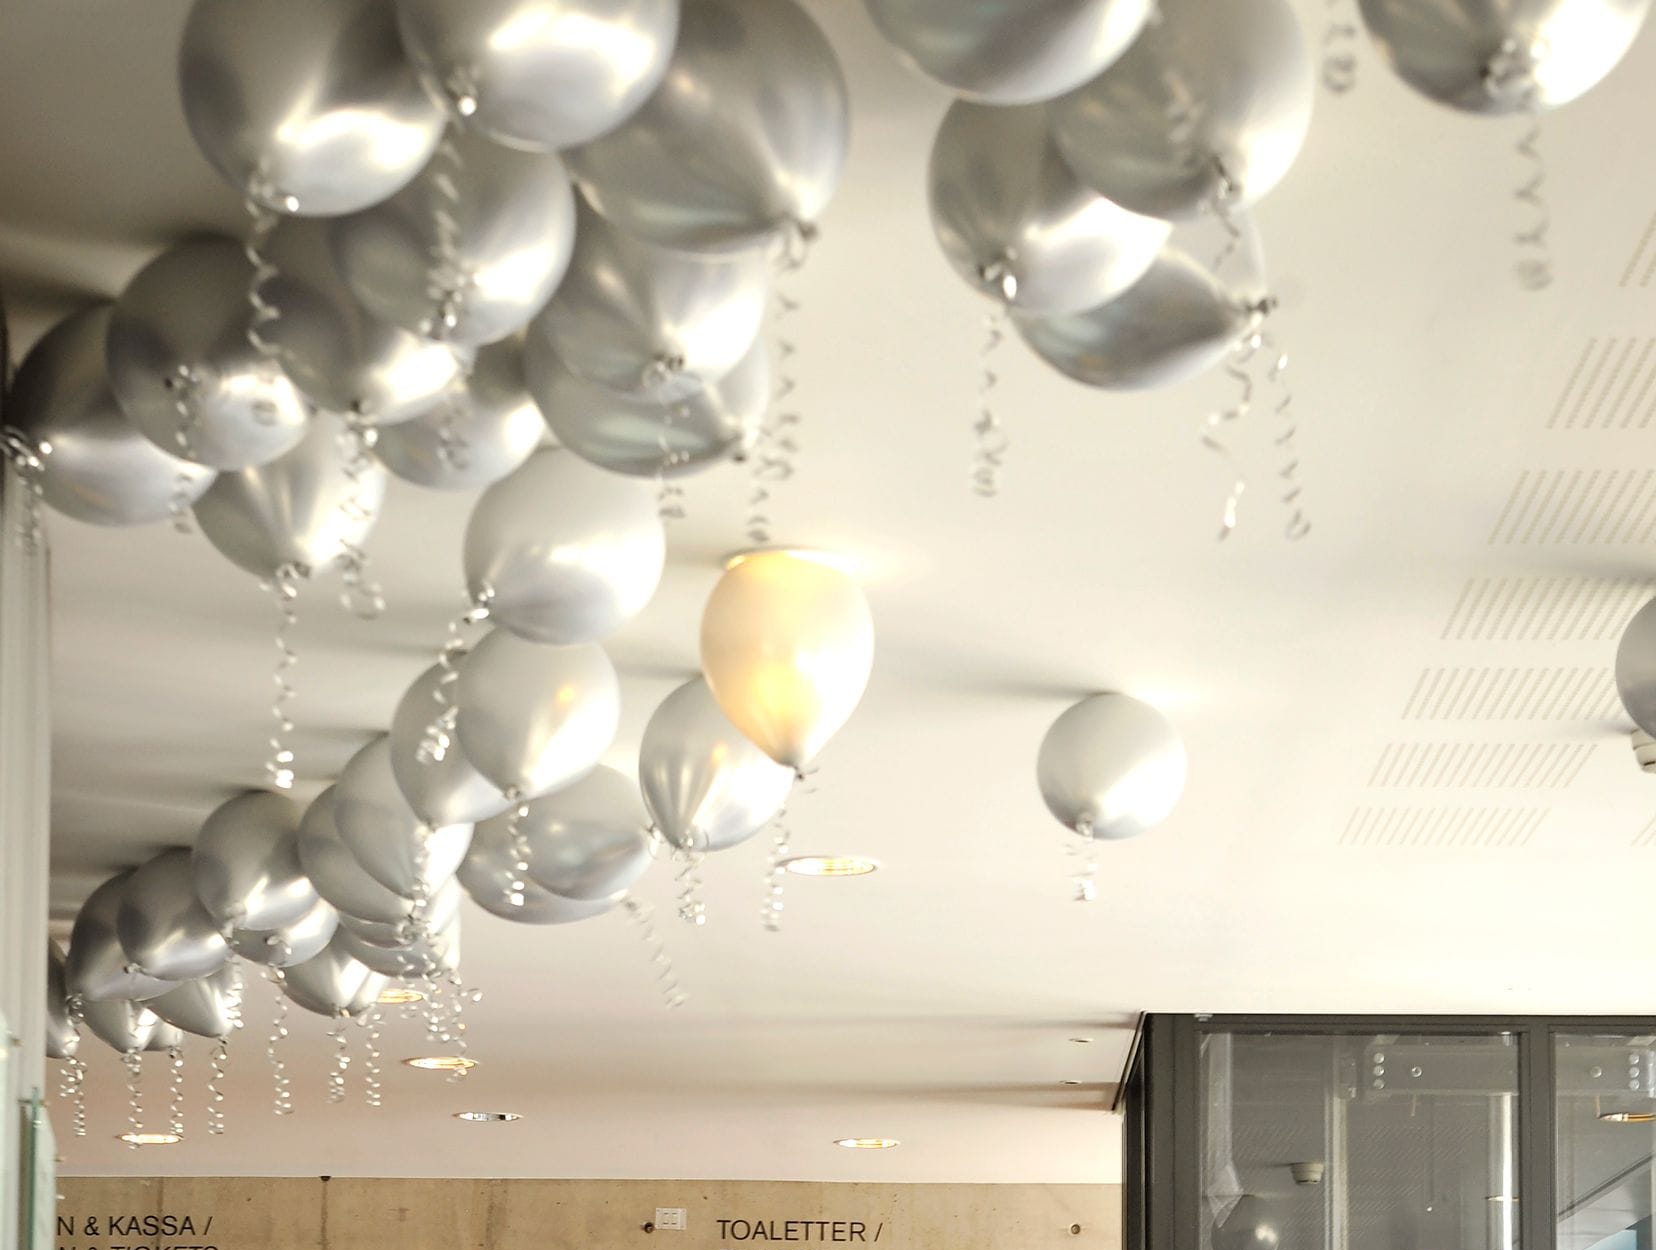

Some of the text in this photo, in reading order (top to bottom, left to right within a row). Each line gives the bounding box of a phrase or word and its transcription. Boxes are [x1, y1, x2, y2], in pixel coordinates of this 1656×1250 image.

[84, 1216, 100, 1236] &
[108, 1215, 196, 1236] KASSA
[203, 1216, 213, 1236] /
[716, 1219, 883, 1242] TOALETTER /
